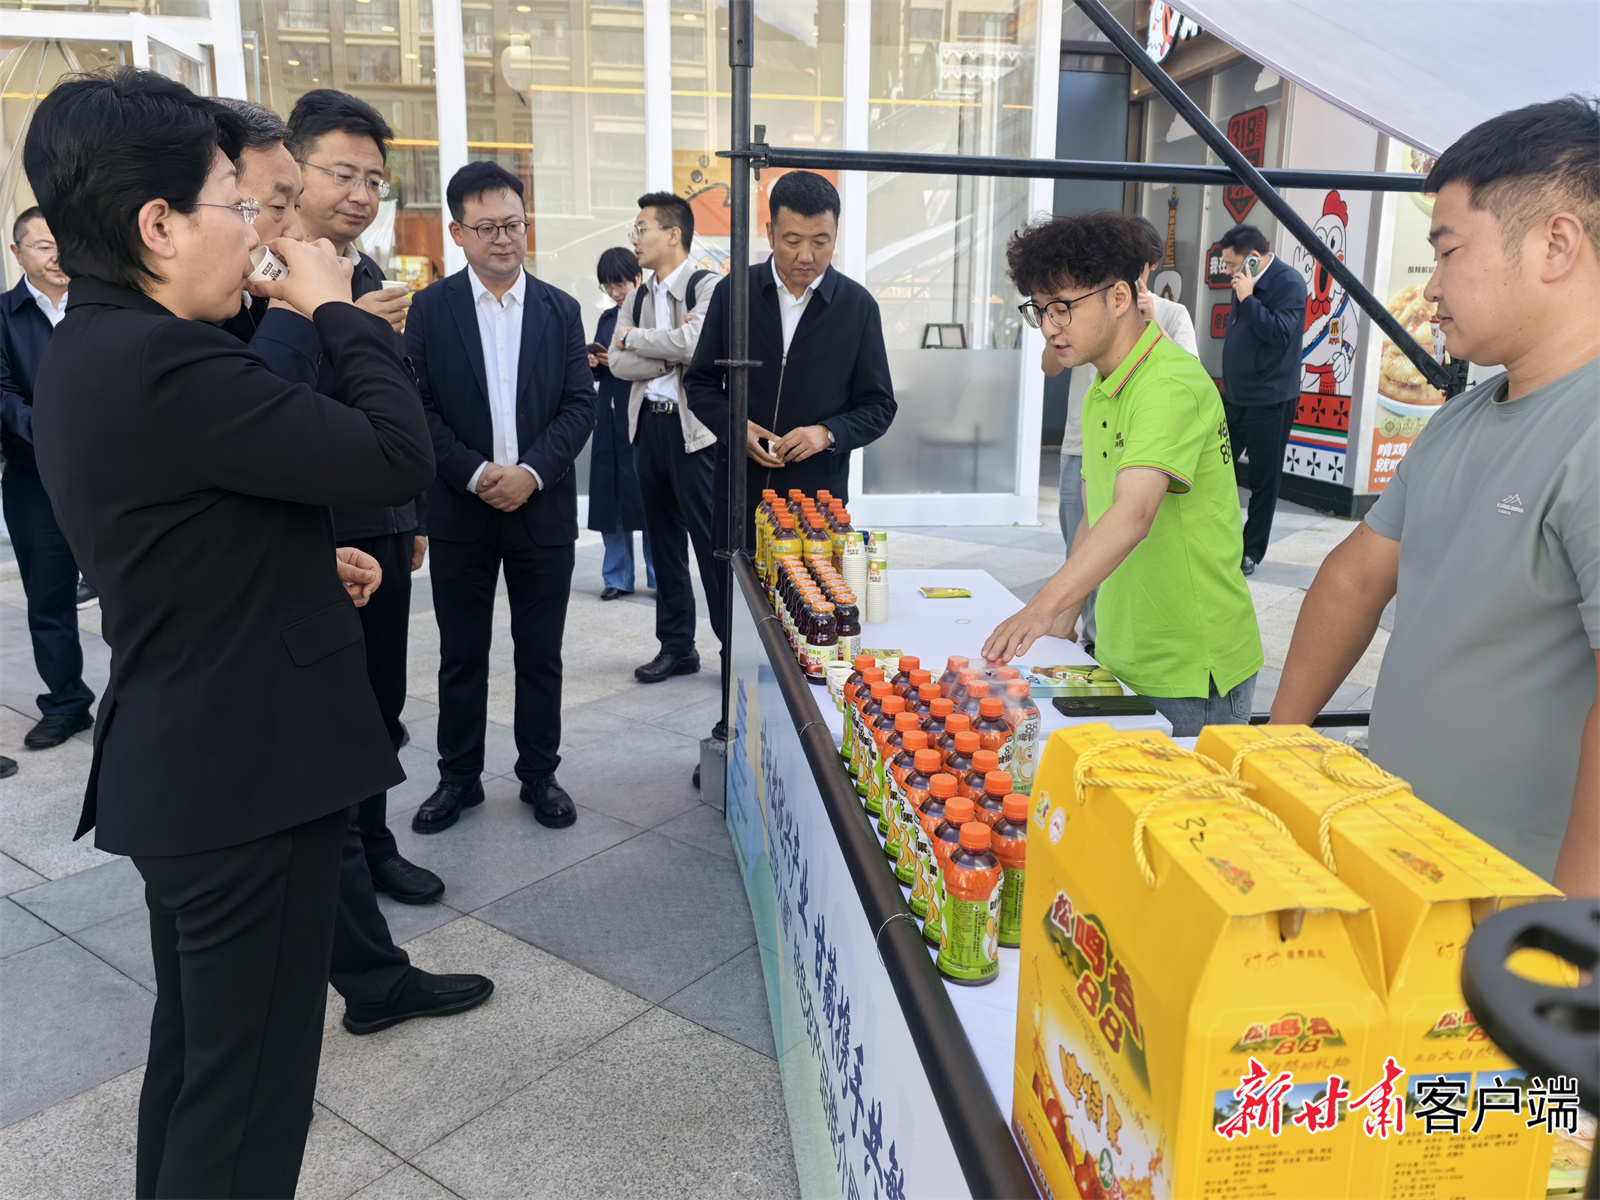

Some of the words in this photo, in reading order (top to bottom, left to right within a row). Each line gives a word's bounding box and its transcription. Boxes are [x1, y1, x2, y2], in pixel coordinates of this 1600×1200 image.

[1230, 114, 1256, 149] 318
[1377, 442, 1412, 458] 啃鸡
[1074, 970, 1125, 1057] 88
[1273, 1038, 1321, 1056] 88
[1219, 1056, 1350, 1078] 来自自然的礼物
